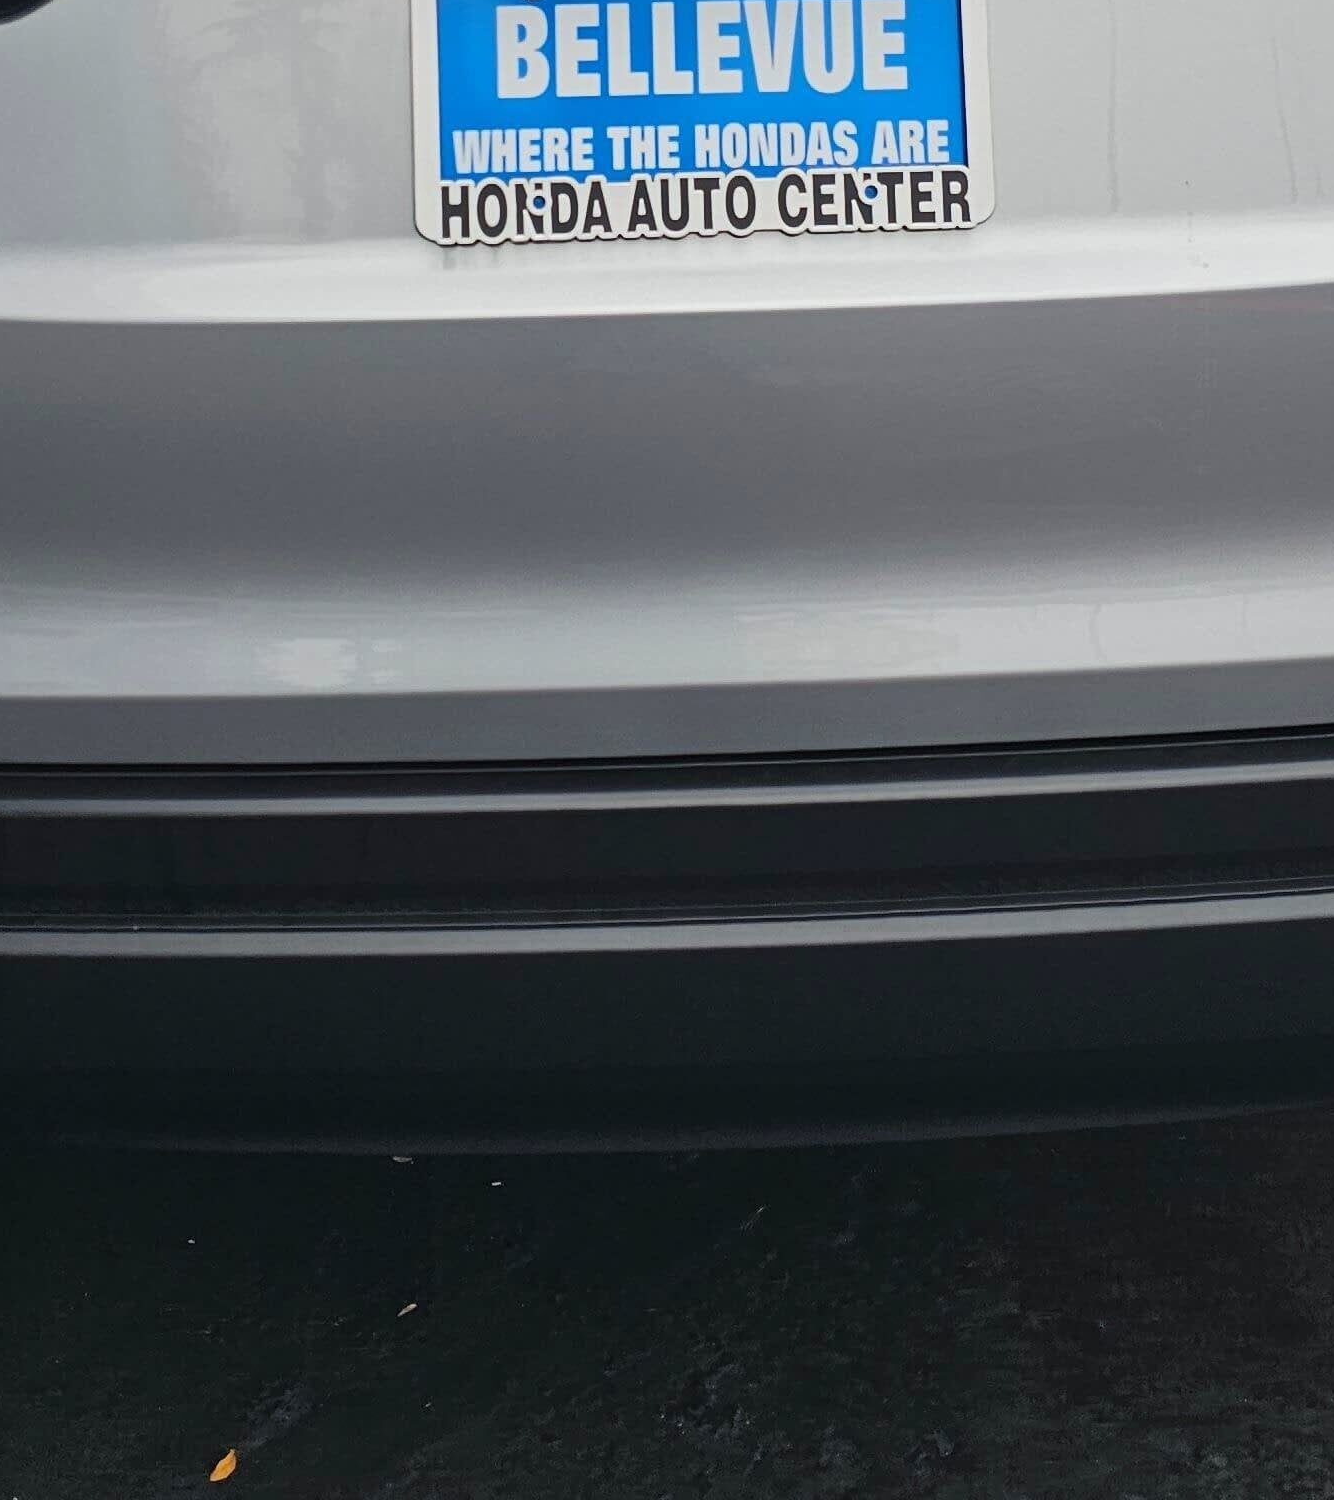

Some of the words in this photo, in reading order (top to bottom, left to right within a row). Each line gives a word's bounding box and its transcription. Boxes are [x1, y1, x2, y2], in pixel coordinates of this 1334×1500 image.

[453, 128, 594, 174] WHERE
[607, 125, 681, 170] THE
[694, 121, 860, 168] HONDAS
[871, 119, 949, 165] ARE
[440, 180, 612, 238] HONDA
[628, 174, 754, 231] AUTO
[777, 170, 971, 227] CENTER
